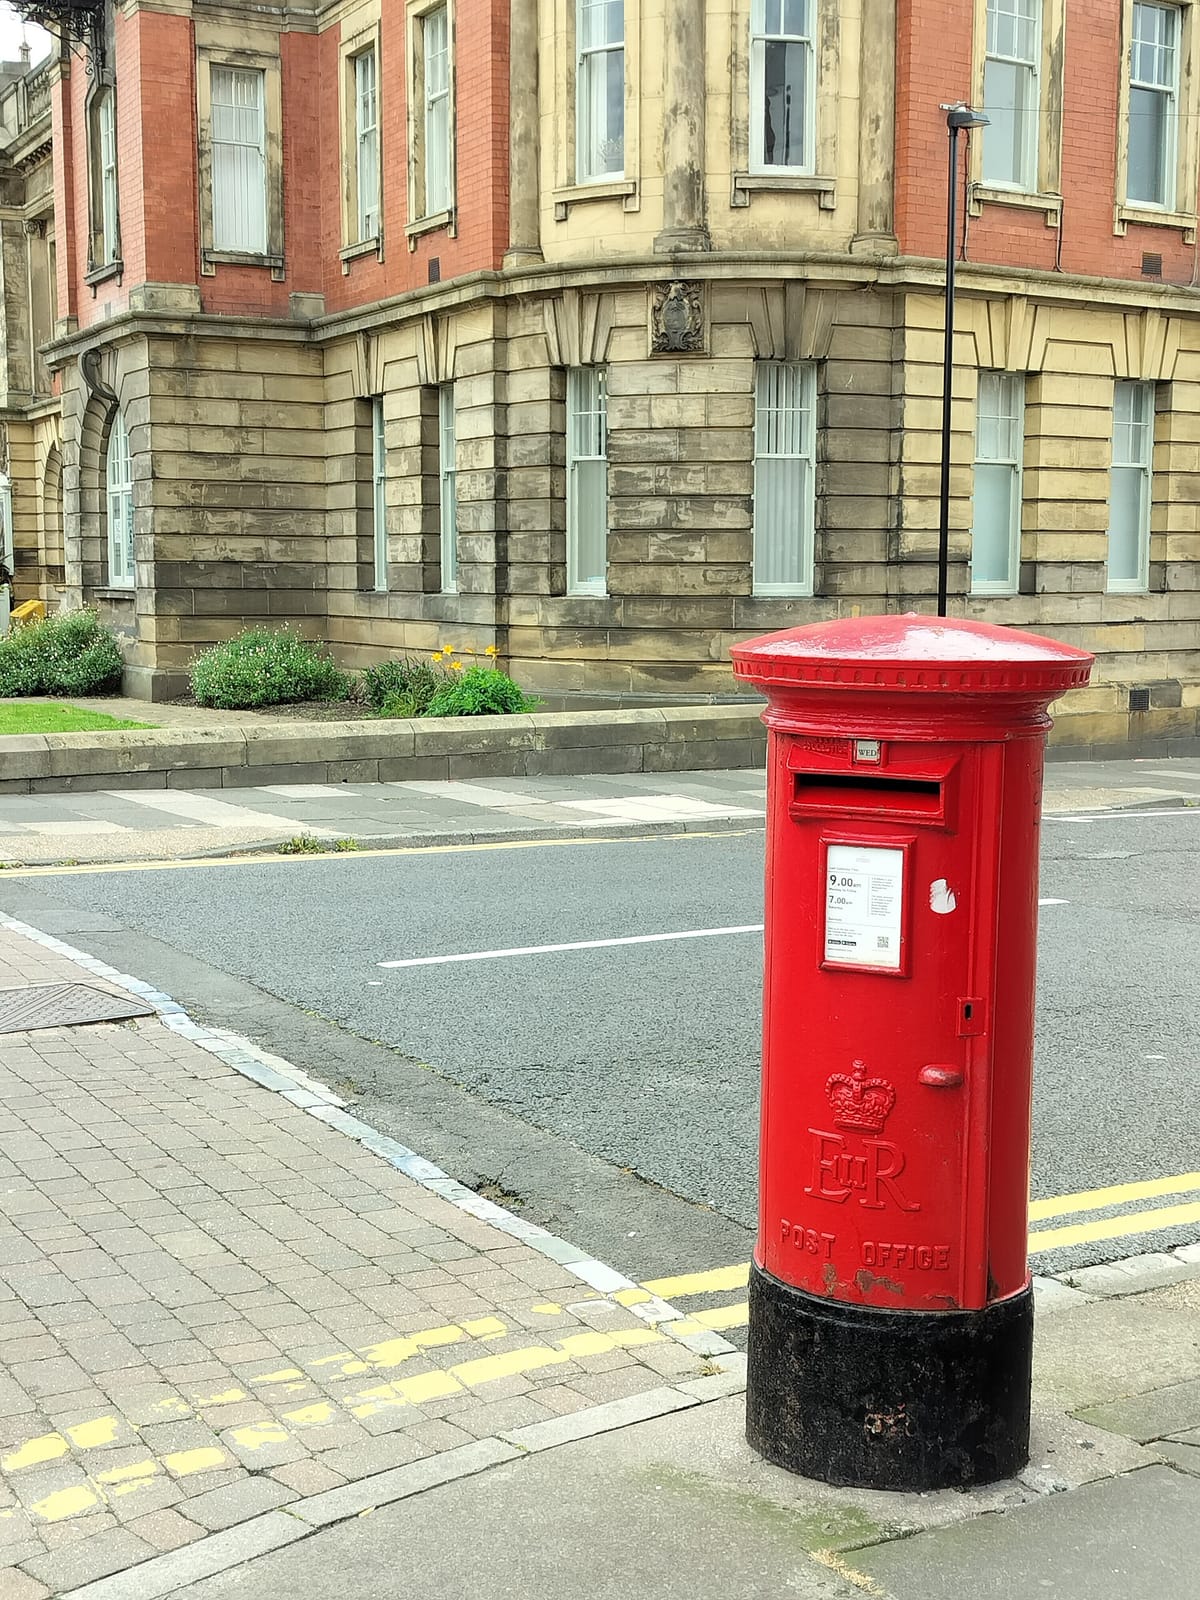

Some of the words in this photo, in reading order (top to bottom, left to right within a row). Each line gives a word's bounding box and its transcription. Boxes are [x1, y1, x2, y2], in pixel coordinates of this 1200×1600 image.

[858, 749, 877, 757] WED
[828, 895, 853, 905] 7.00
[780, 1218, 836, 1258] POST
[862, 1241, 950, 1271] OFFICE
